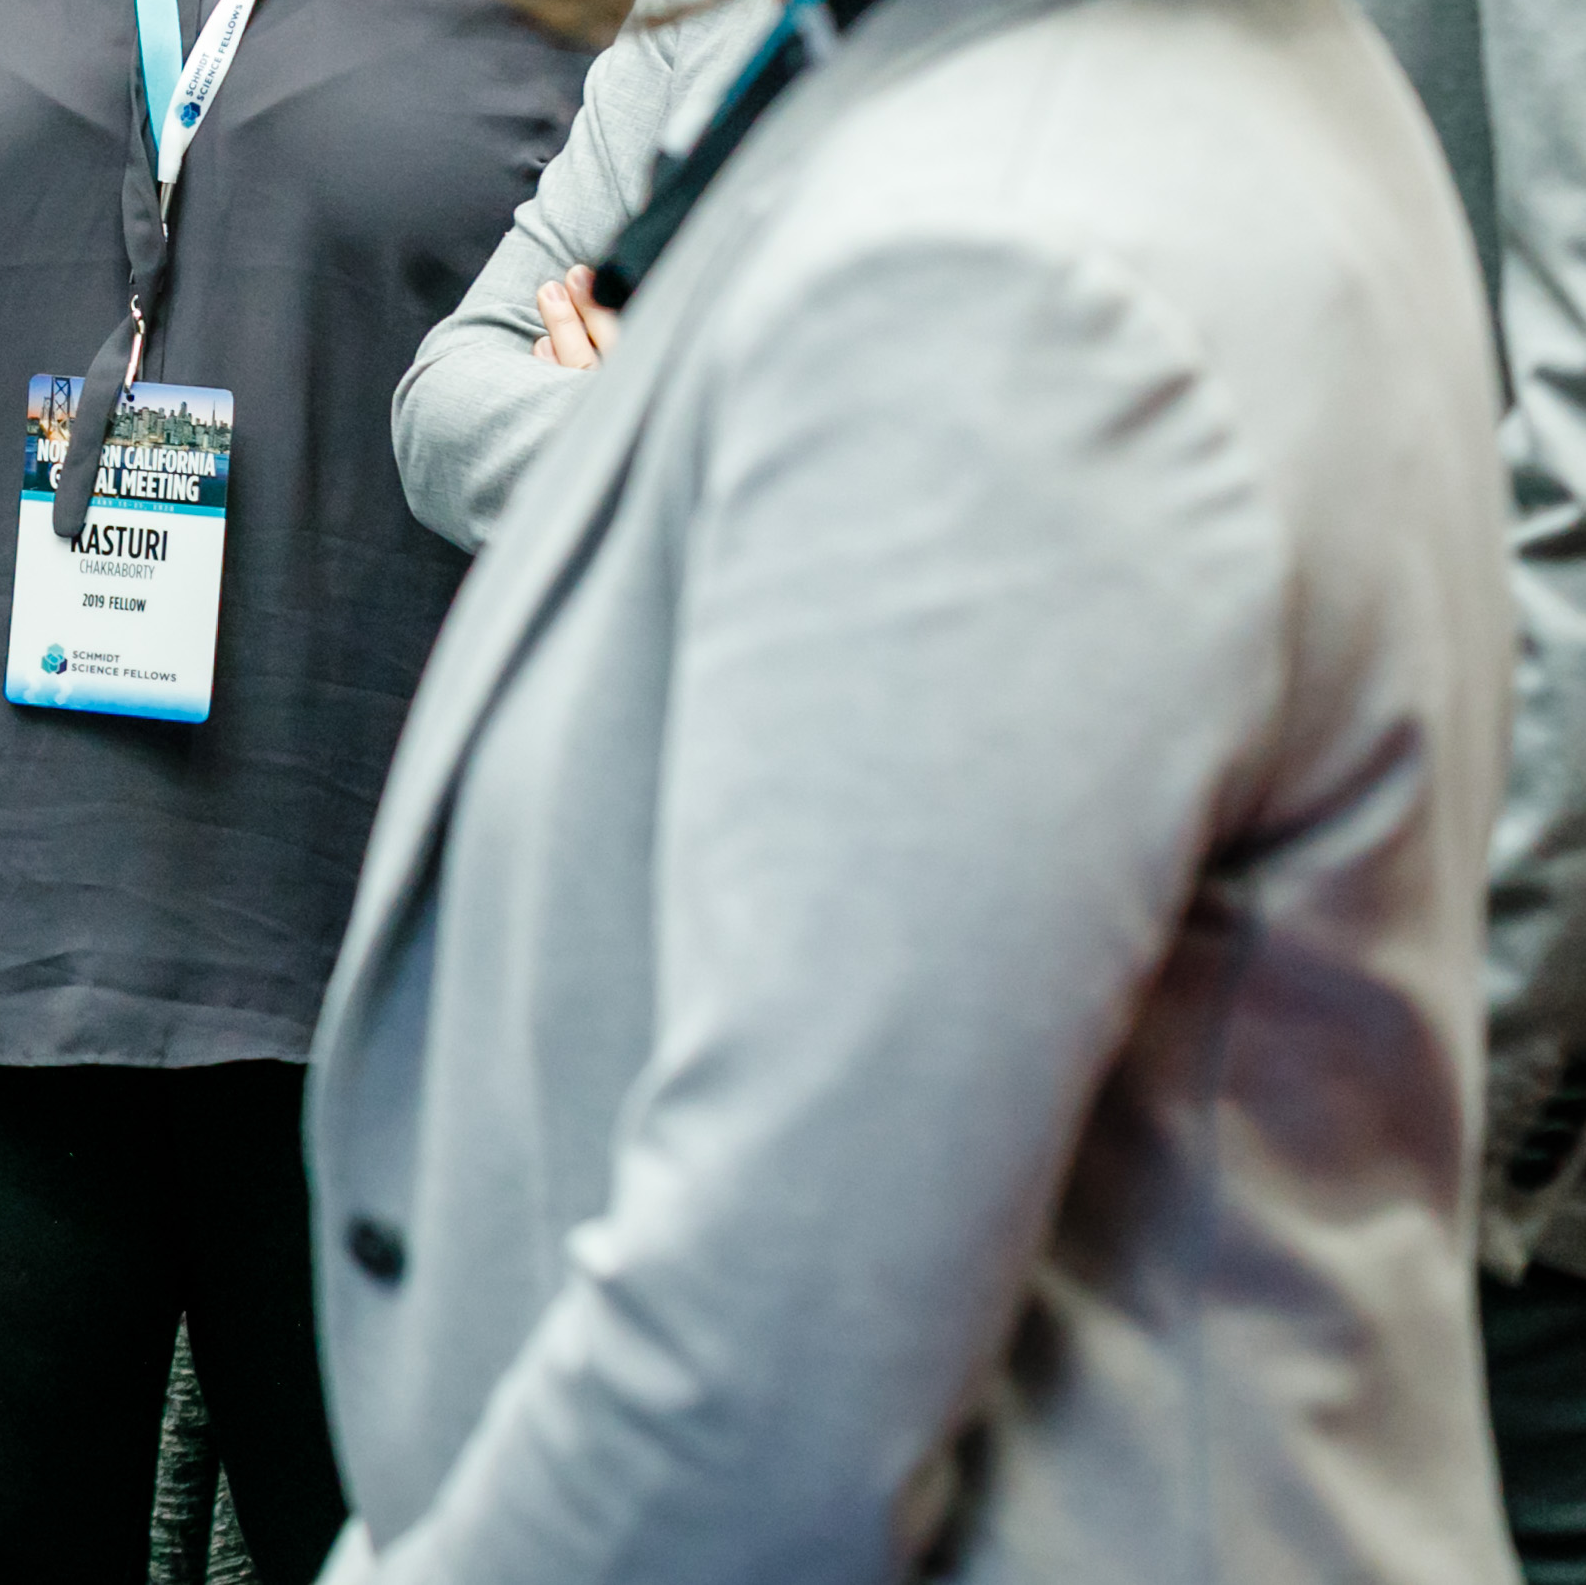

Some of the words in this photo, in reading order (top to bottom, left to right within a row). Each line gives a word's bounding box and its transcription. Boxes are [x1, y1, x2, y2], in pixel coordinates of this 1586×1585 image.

[197, 56, 222, 102] SCIENCE
[218, 4, 243, 55] FELLOWS
[186, 52, 210, 97] SCHMIDT
[124, 446, 217, 477] CALIFORNIA
[120, 469, 200, 502] MEETING
[79, 558, 155, 580] CHAKRABORTY
[82, 593, 105, 608] 2019
[109, 596, 147, 612] FELLOW
[72, 650, 120, 663] SCHMIDT
[71, 663, 119, 676] SCIENCE
[123, 668, 177, 682] FELLOWS
